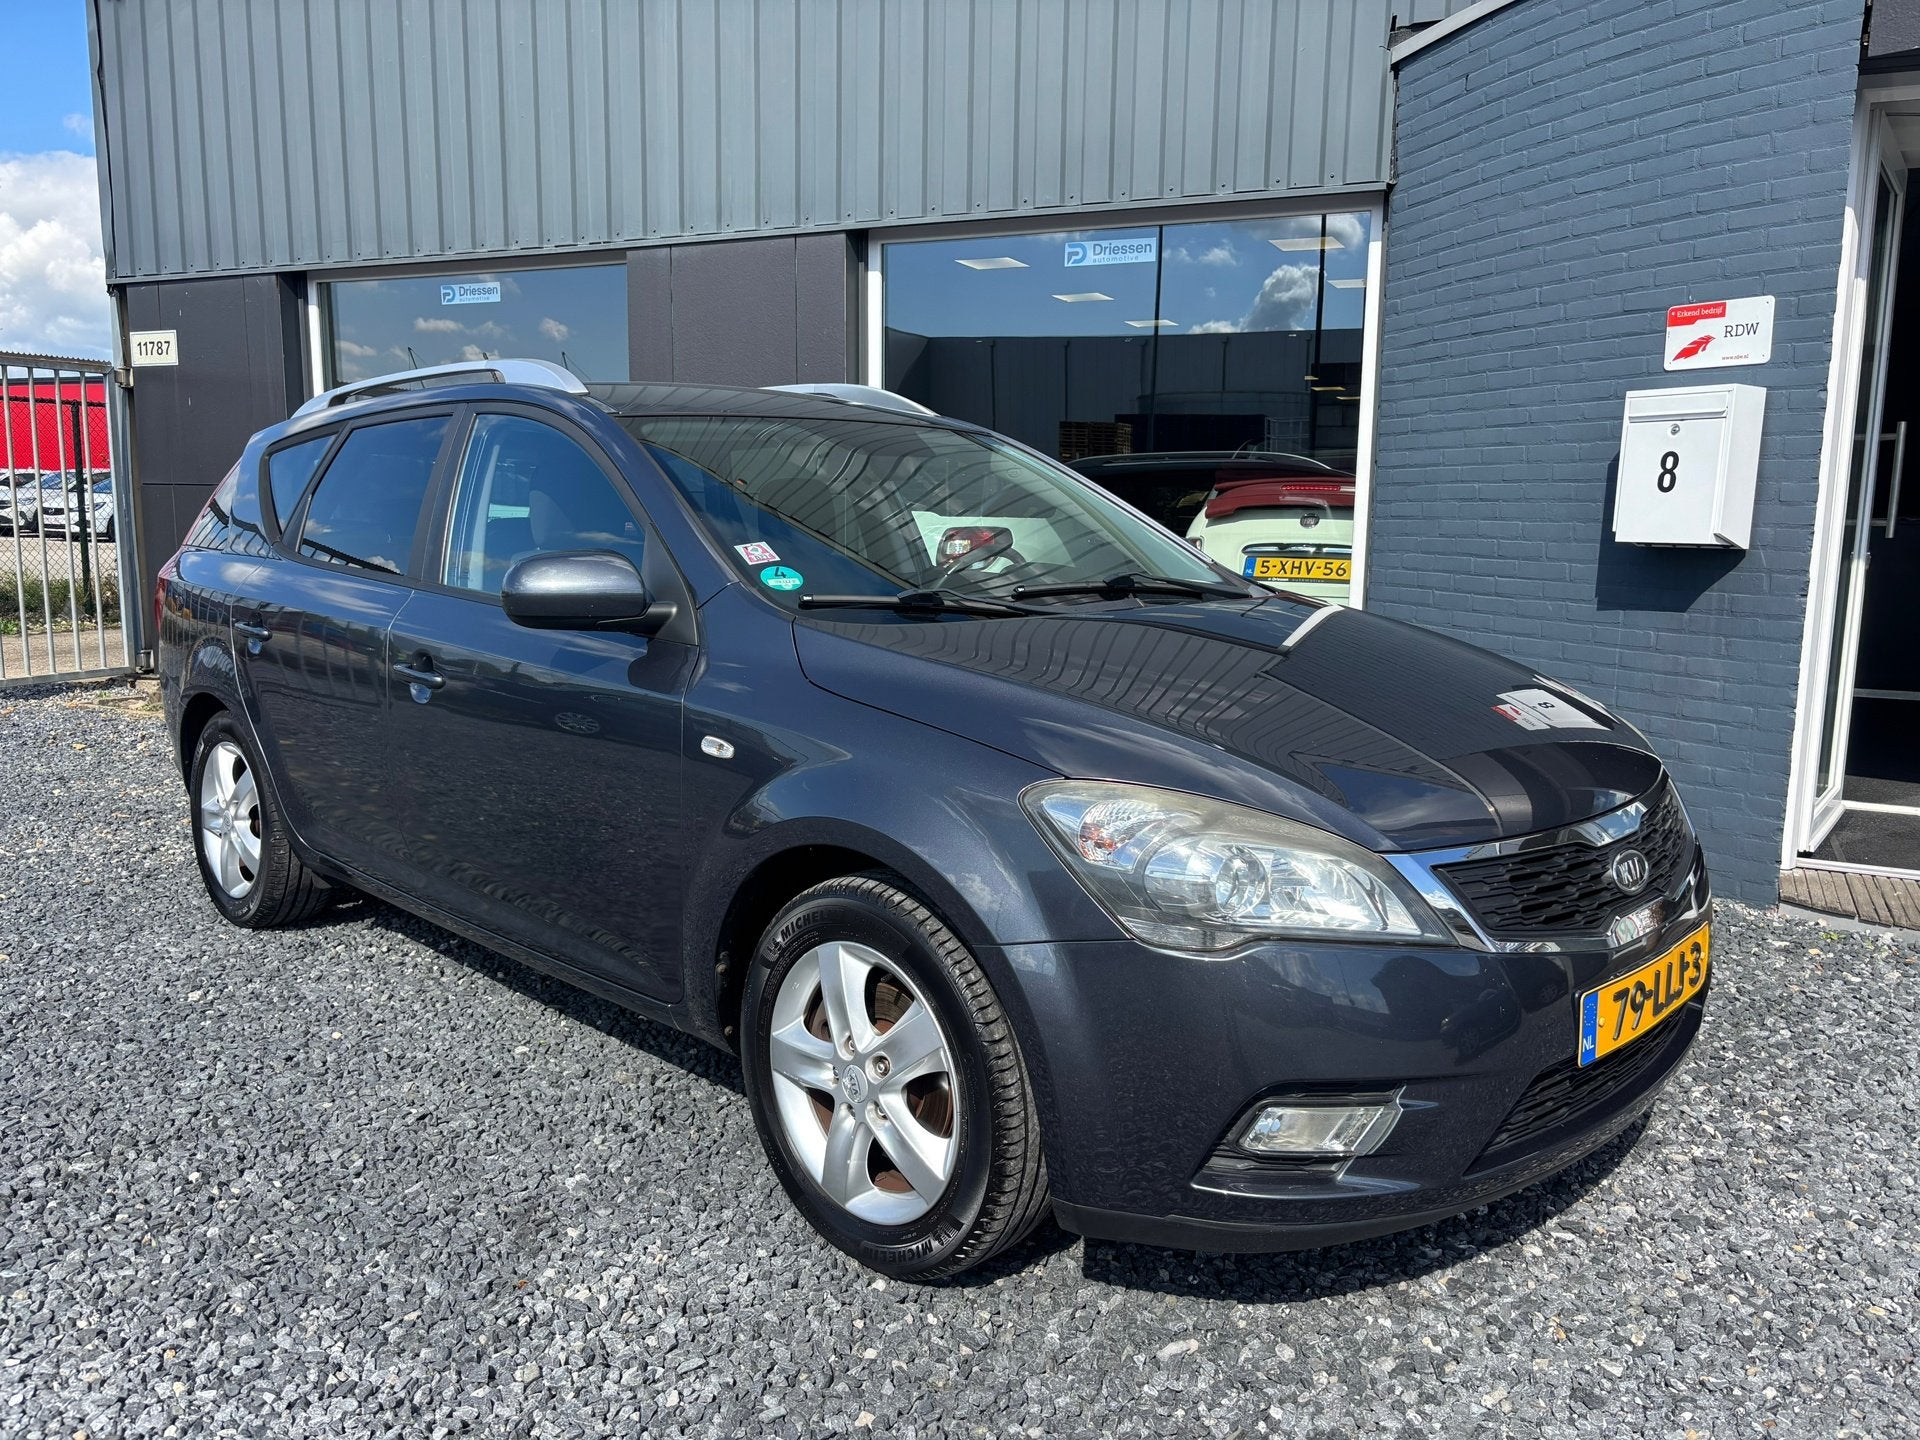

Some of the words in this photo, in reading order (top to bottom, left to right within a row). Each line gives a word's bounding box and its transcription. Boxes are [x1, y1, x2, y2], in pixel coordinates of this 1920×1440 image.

[1092, 242, 1152, 257] Driessen
[1092, 256, 1139, 264] automotive
[458, 285, 498, 297] Driessen
[1676, 307, 1700, 318] Erkend
[1701, 305, 1723, 316] bedrijf
[1723, 322, 1760, 338] RDW
[137, 340, 170, 356] 11787
[1657, 450, 1680, 493] 8
[774, 566, 787, 579] 4
[1259, 560, 1347, 577] 5-XHV-56
[1582, 1034, 1595, 1053] NL
